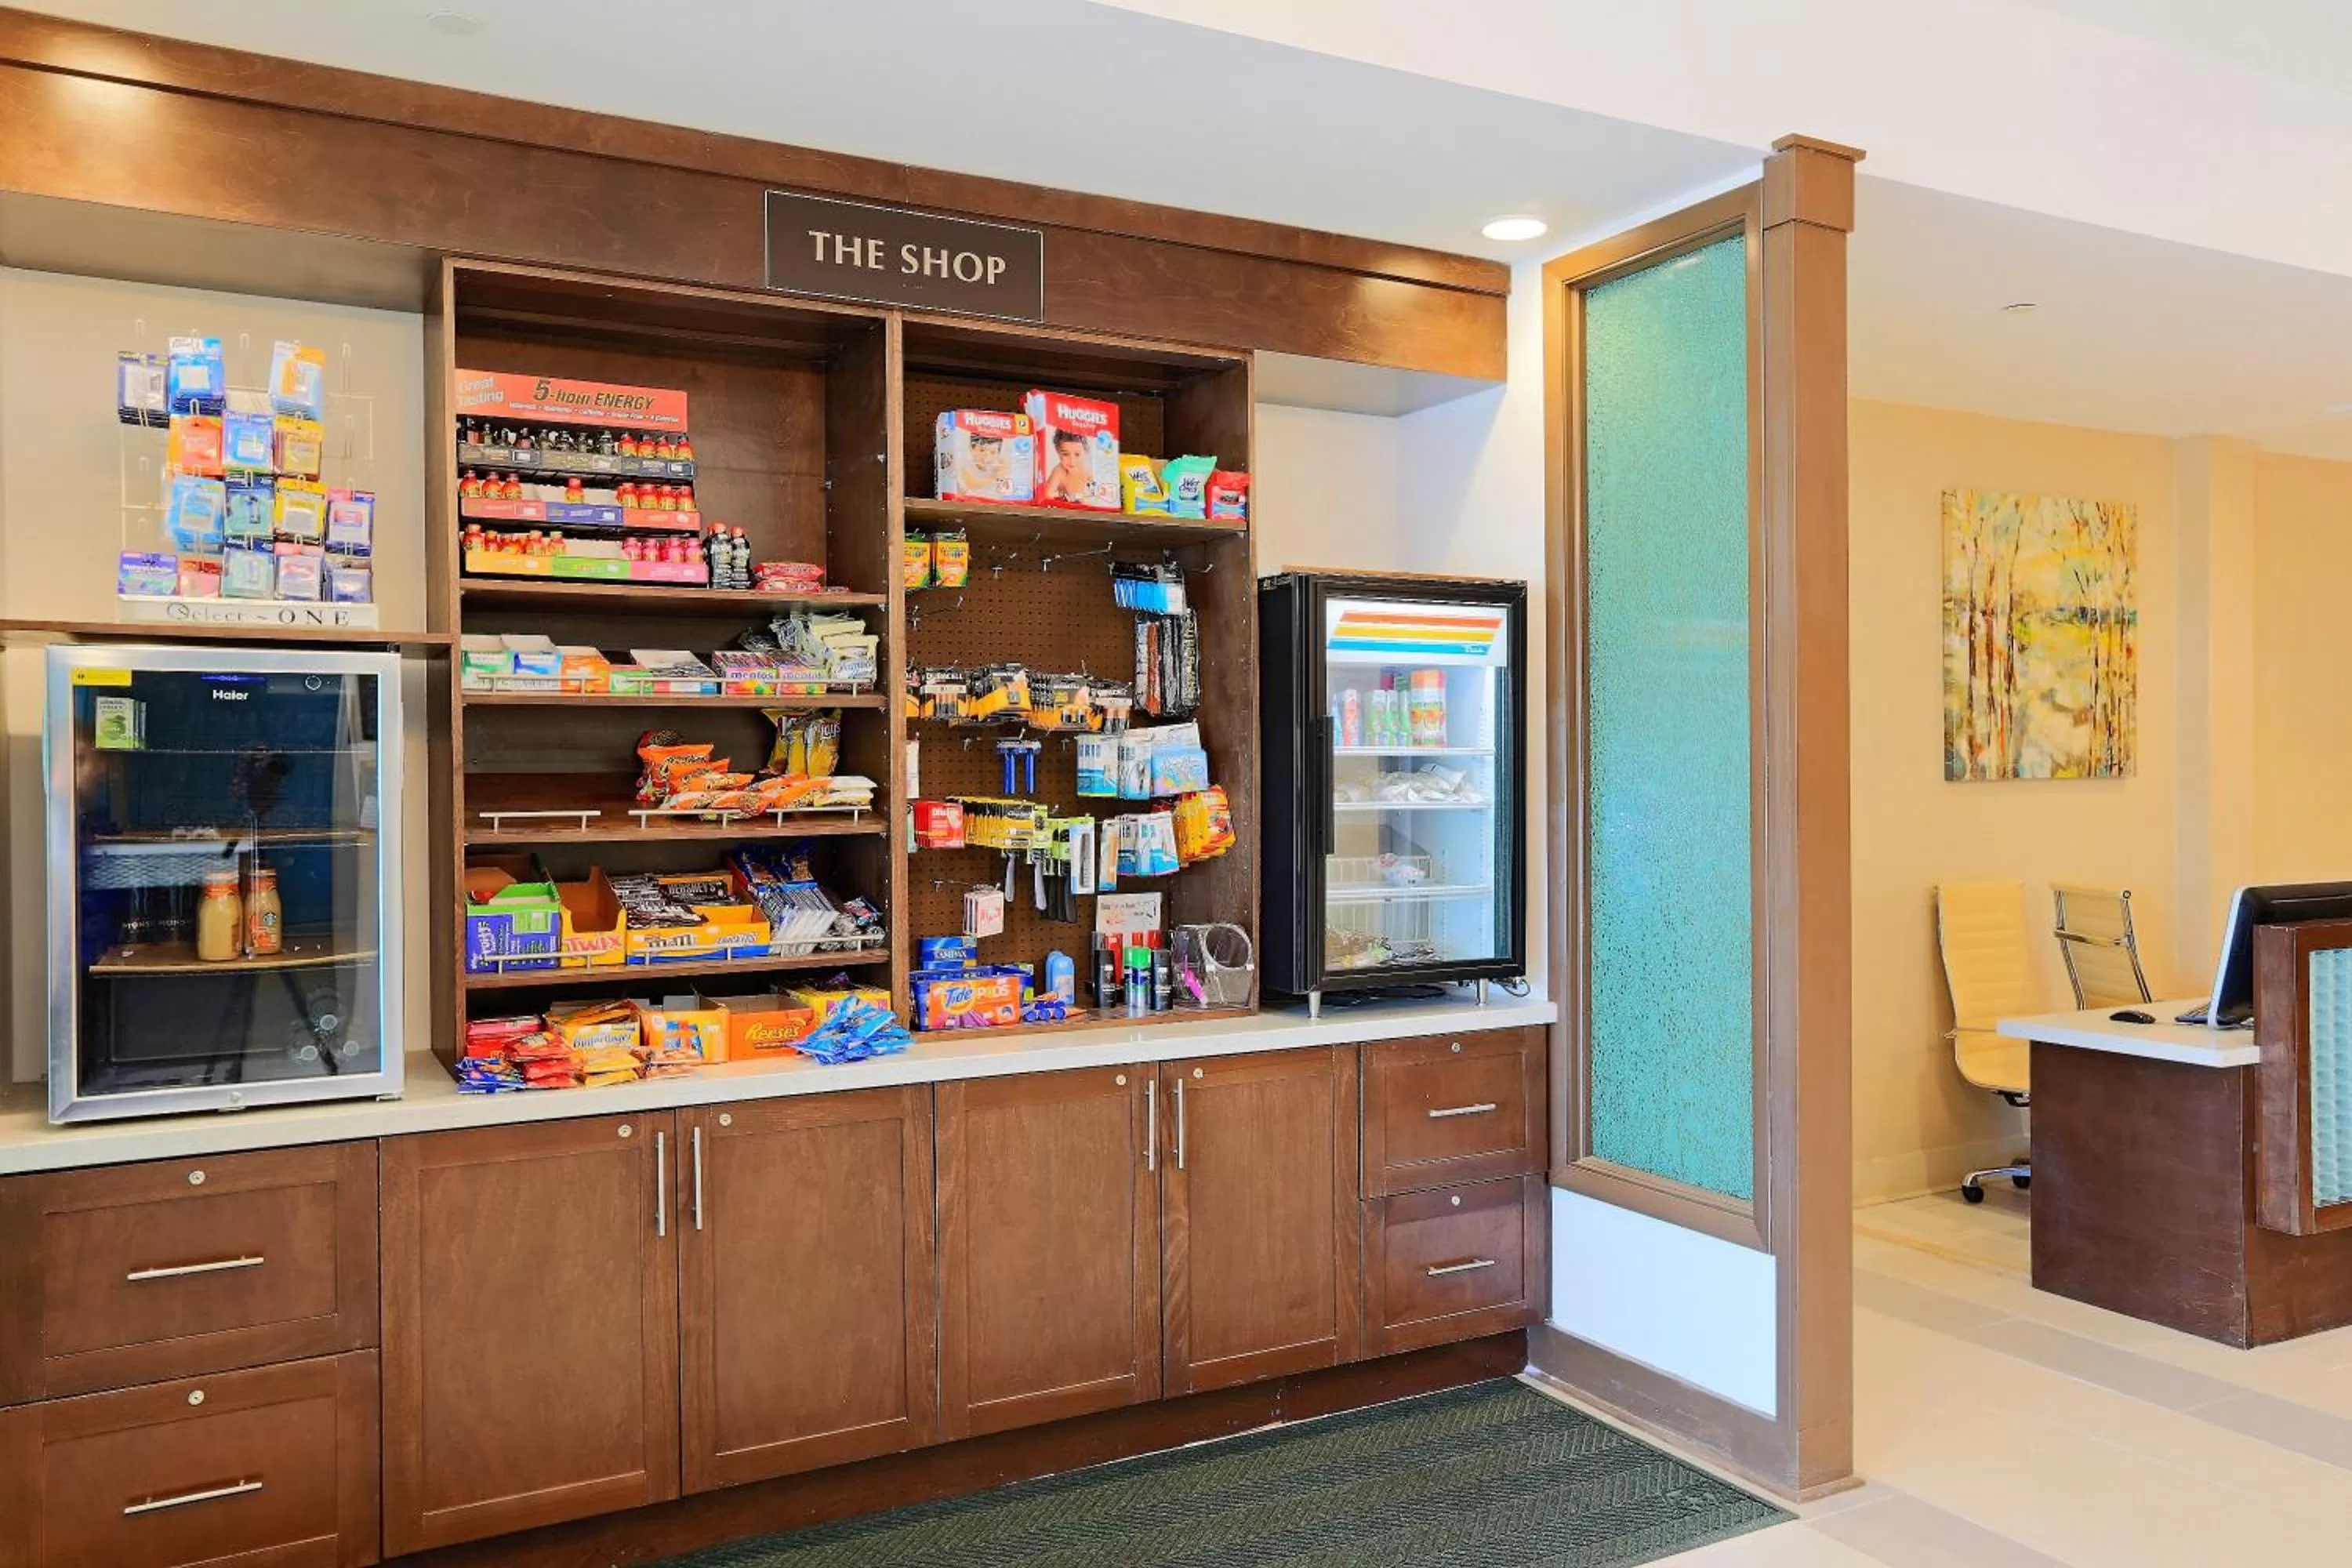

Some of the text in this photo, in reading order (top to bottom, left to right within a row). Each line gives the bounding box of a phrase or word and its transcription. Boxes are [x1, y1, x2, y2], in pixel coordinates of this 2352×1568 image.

[808, 230, 1007, 285] THE SHOP
[594, 393, 655, 410] ENERGY
[278, 608, 350, 626] ONE
[730, 671, 774, 680] mentos
[212, 689, 249, 701] Haier
[933, 947, 967, 959] TAMPAX
[944, 986, 974, 1007] Tide
